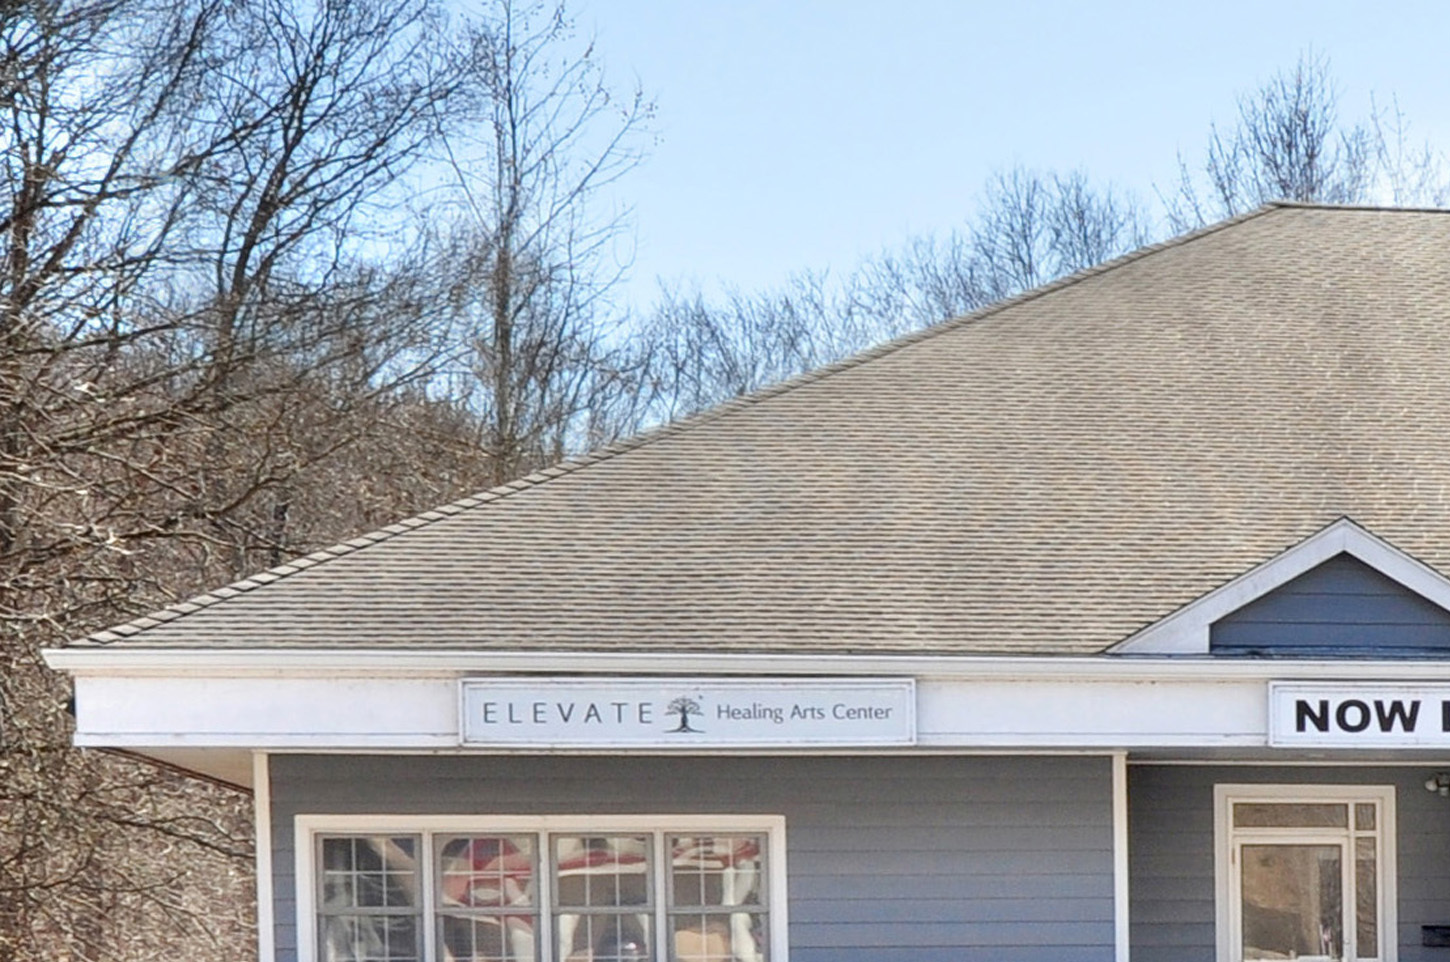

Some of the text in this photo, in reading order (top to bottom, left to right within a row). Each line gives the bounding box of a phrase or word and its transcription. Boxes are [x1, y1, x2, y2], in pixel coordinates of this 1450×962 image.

[483, 702, 893, 724] ELEVATE Healing Arts Center
[1295, 699, 1421, 733] NOW
